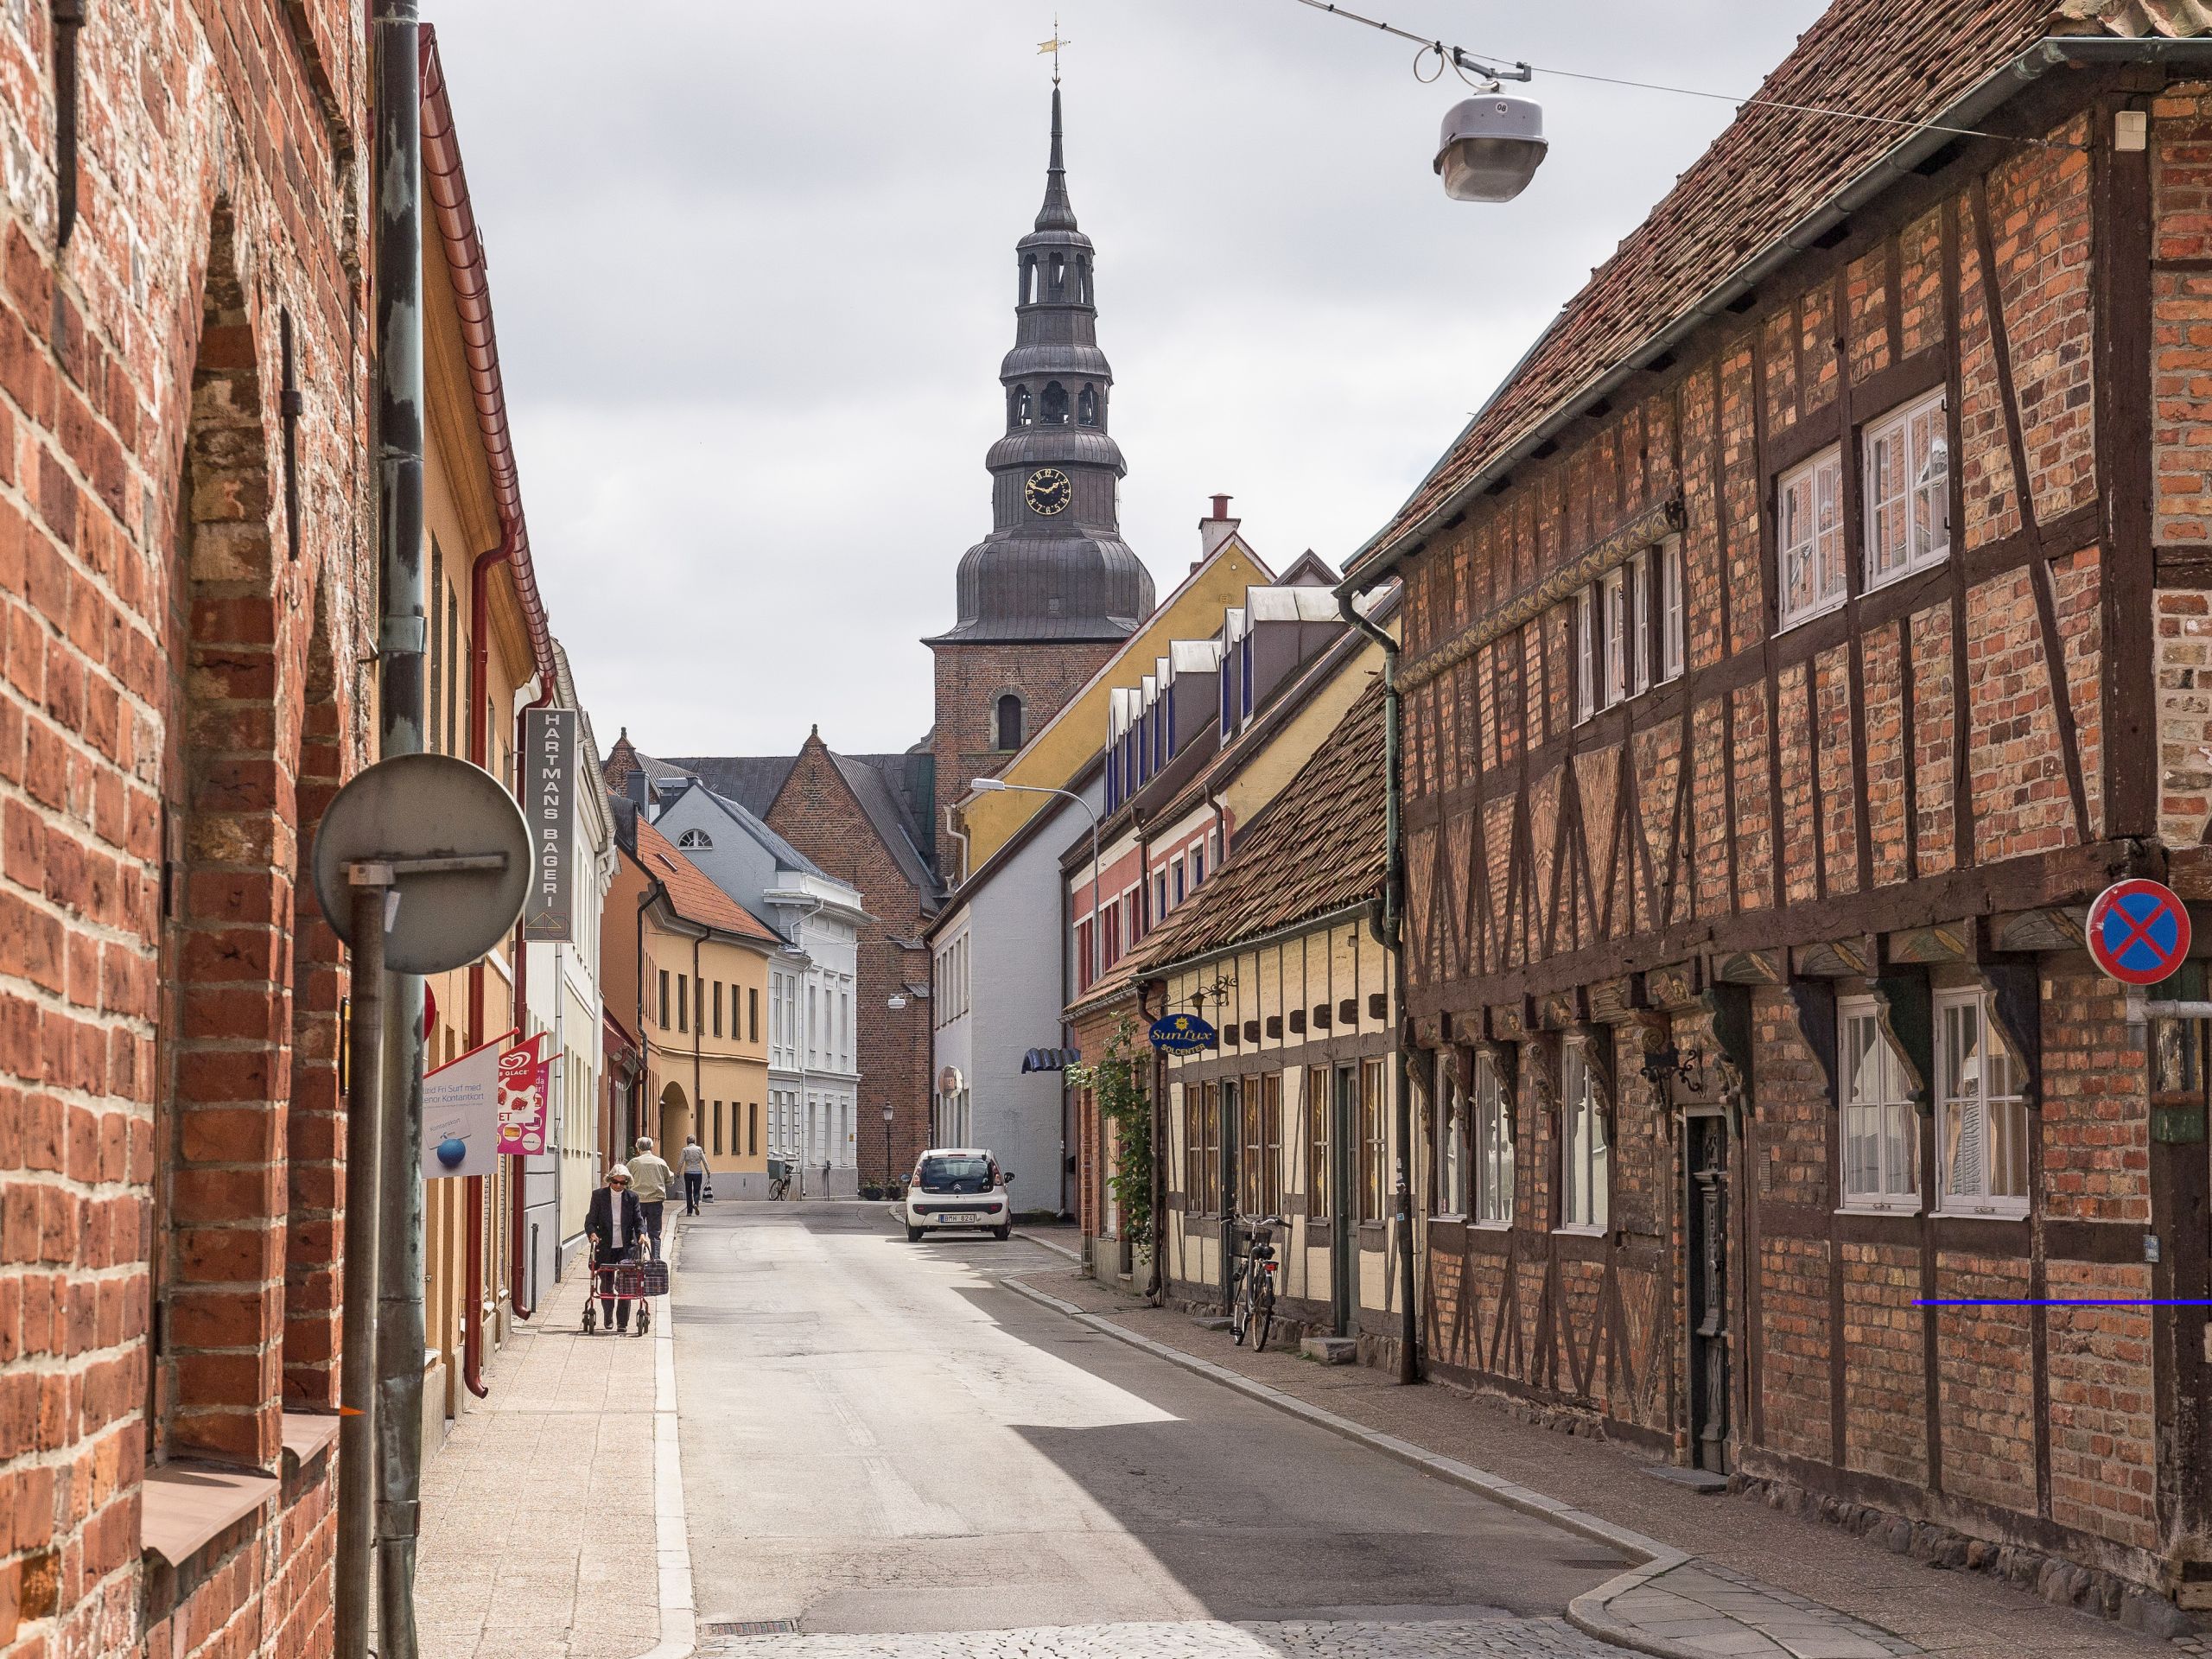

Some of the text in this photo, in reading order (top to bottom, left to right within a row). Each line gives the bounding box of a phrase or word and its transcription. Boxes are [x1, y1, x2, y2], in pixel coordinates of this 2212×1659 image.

[1497, 103, 1507, 112] 08
[1045, 469, 1052, 478] 12
[542, 713, 562, 907] HARTMANS BAGERI
[1160, 1043, 1206, 1055] SOLCENTER
[536, 1076, 544, 1084] da
[448, 1084, 464, 1093] Surf
[442, 1092, 484, 1103] Kontantkort
[499, 1112, 512, 1122] ET
